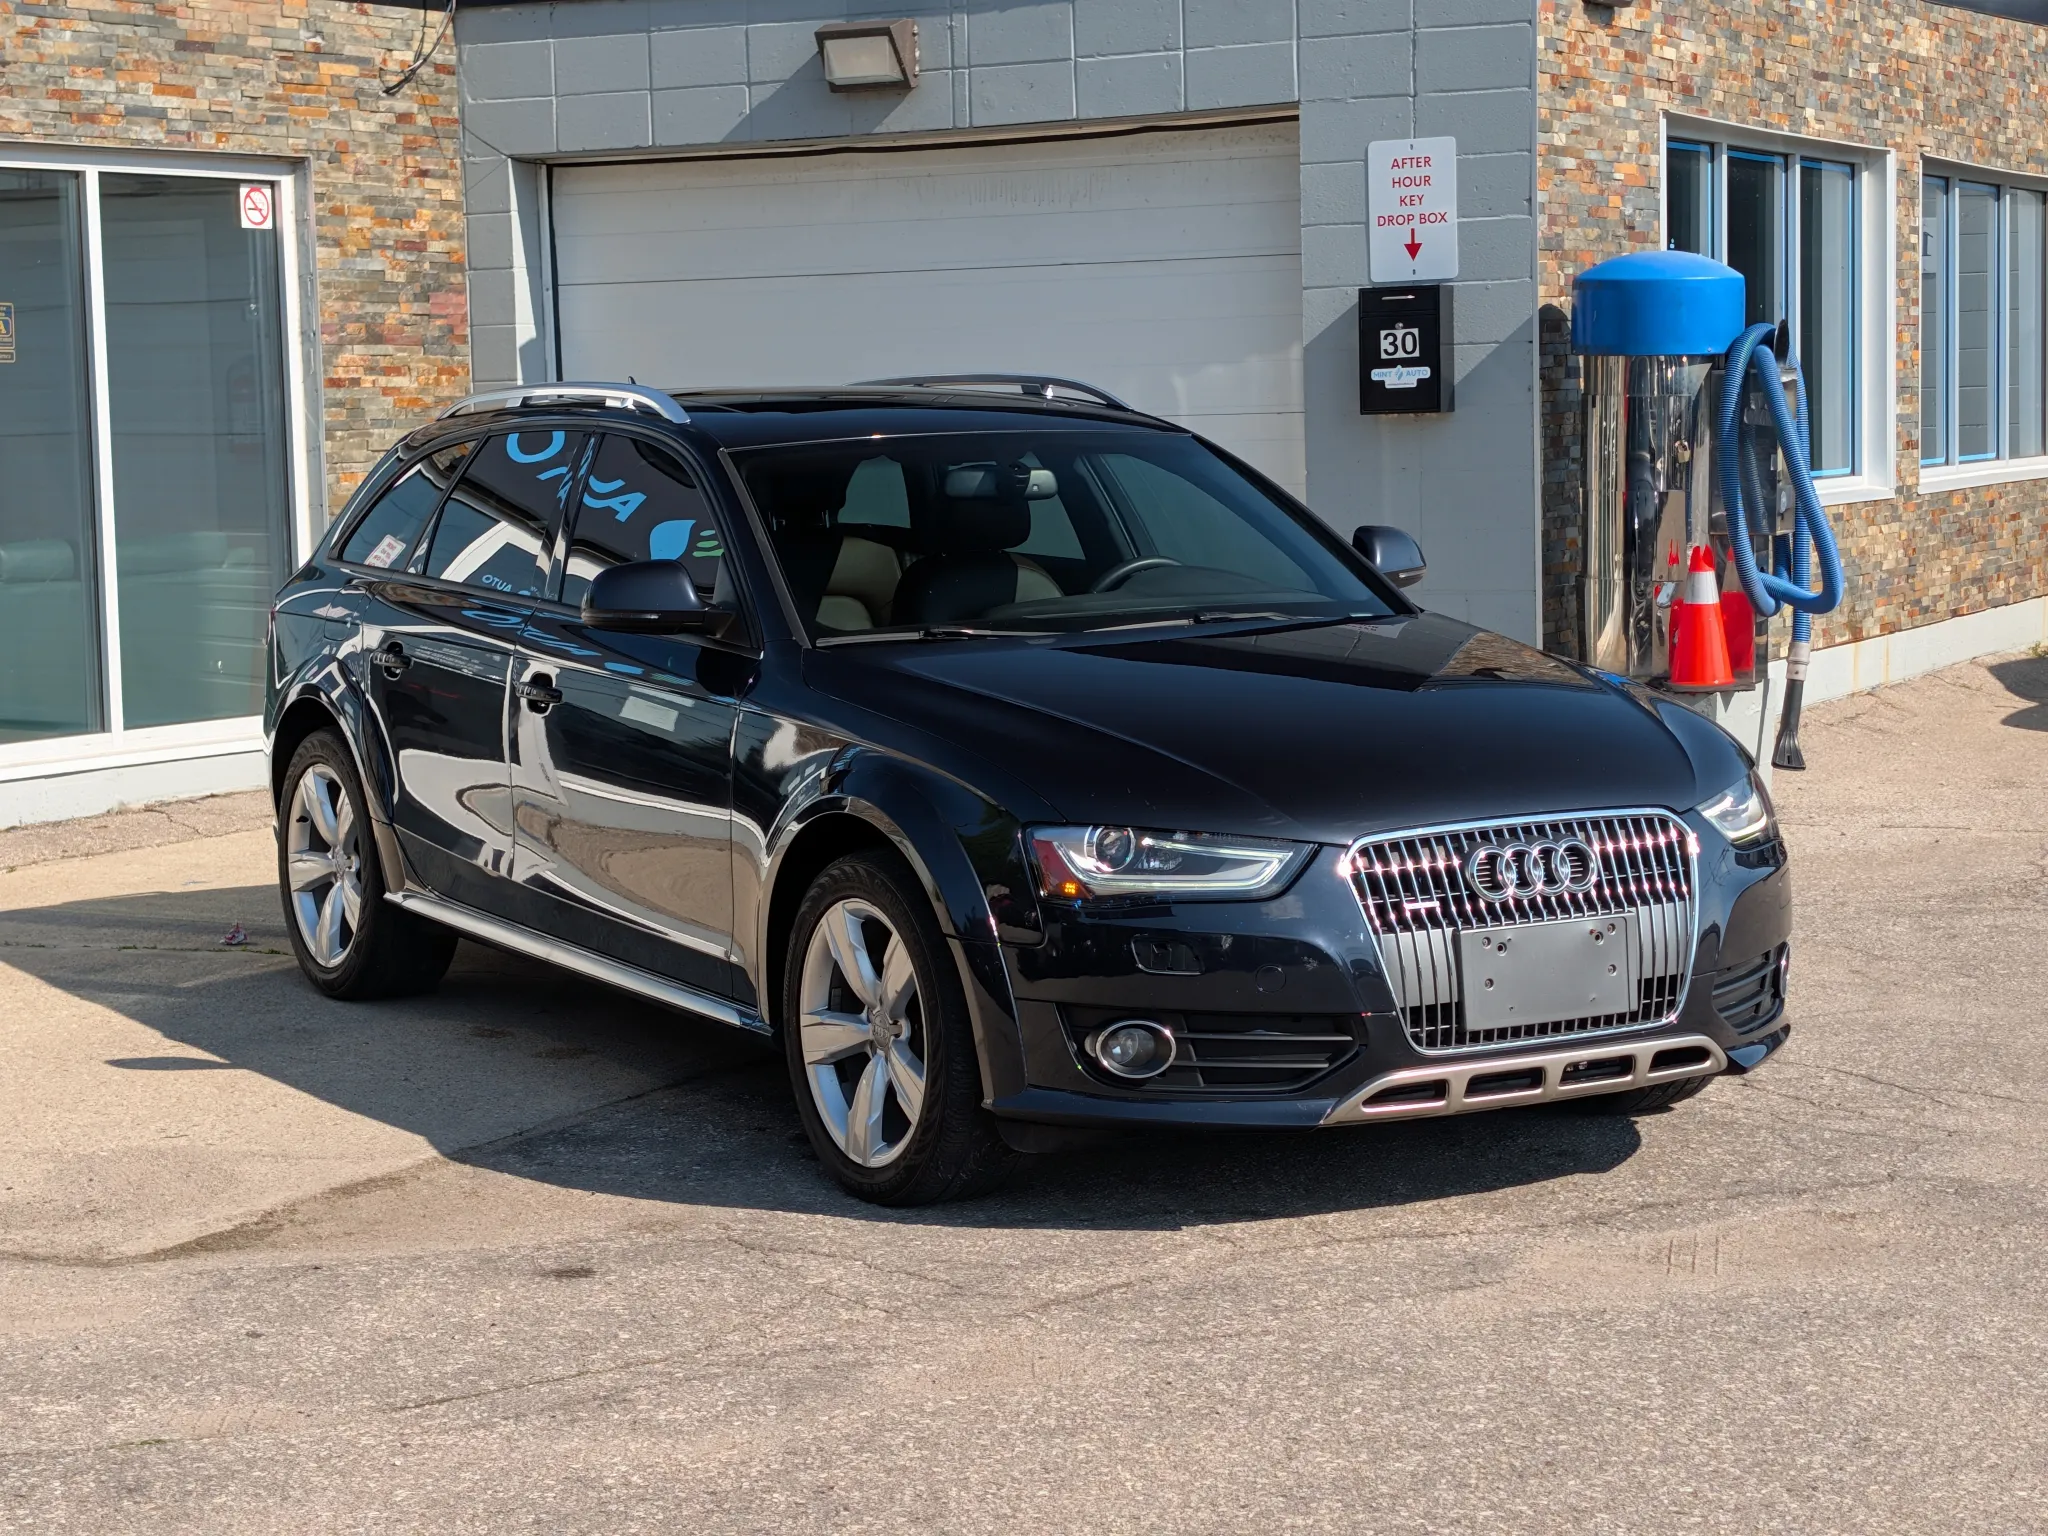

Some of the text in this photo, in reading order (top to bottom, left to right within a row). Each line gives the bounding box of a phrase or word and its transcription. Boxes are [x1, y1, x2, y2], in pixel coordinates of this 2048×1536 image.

[1391, 156, 1432, 170] AFTER
[1392, 175, 1432, 188] HOUR
[1399, 194, 1424, 207] KEY
[1377, 211, 1448, 227] DROP BOX
[1383, 331, 1418, 356] 30
[1373, 369, 1429, 378] MINT AUTO
